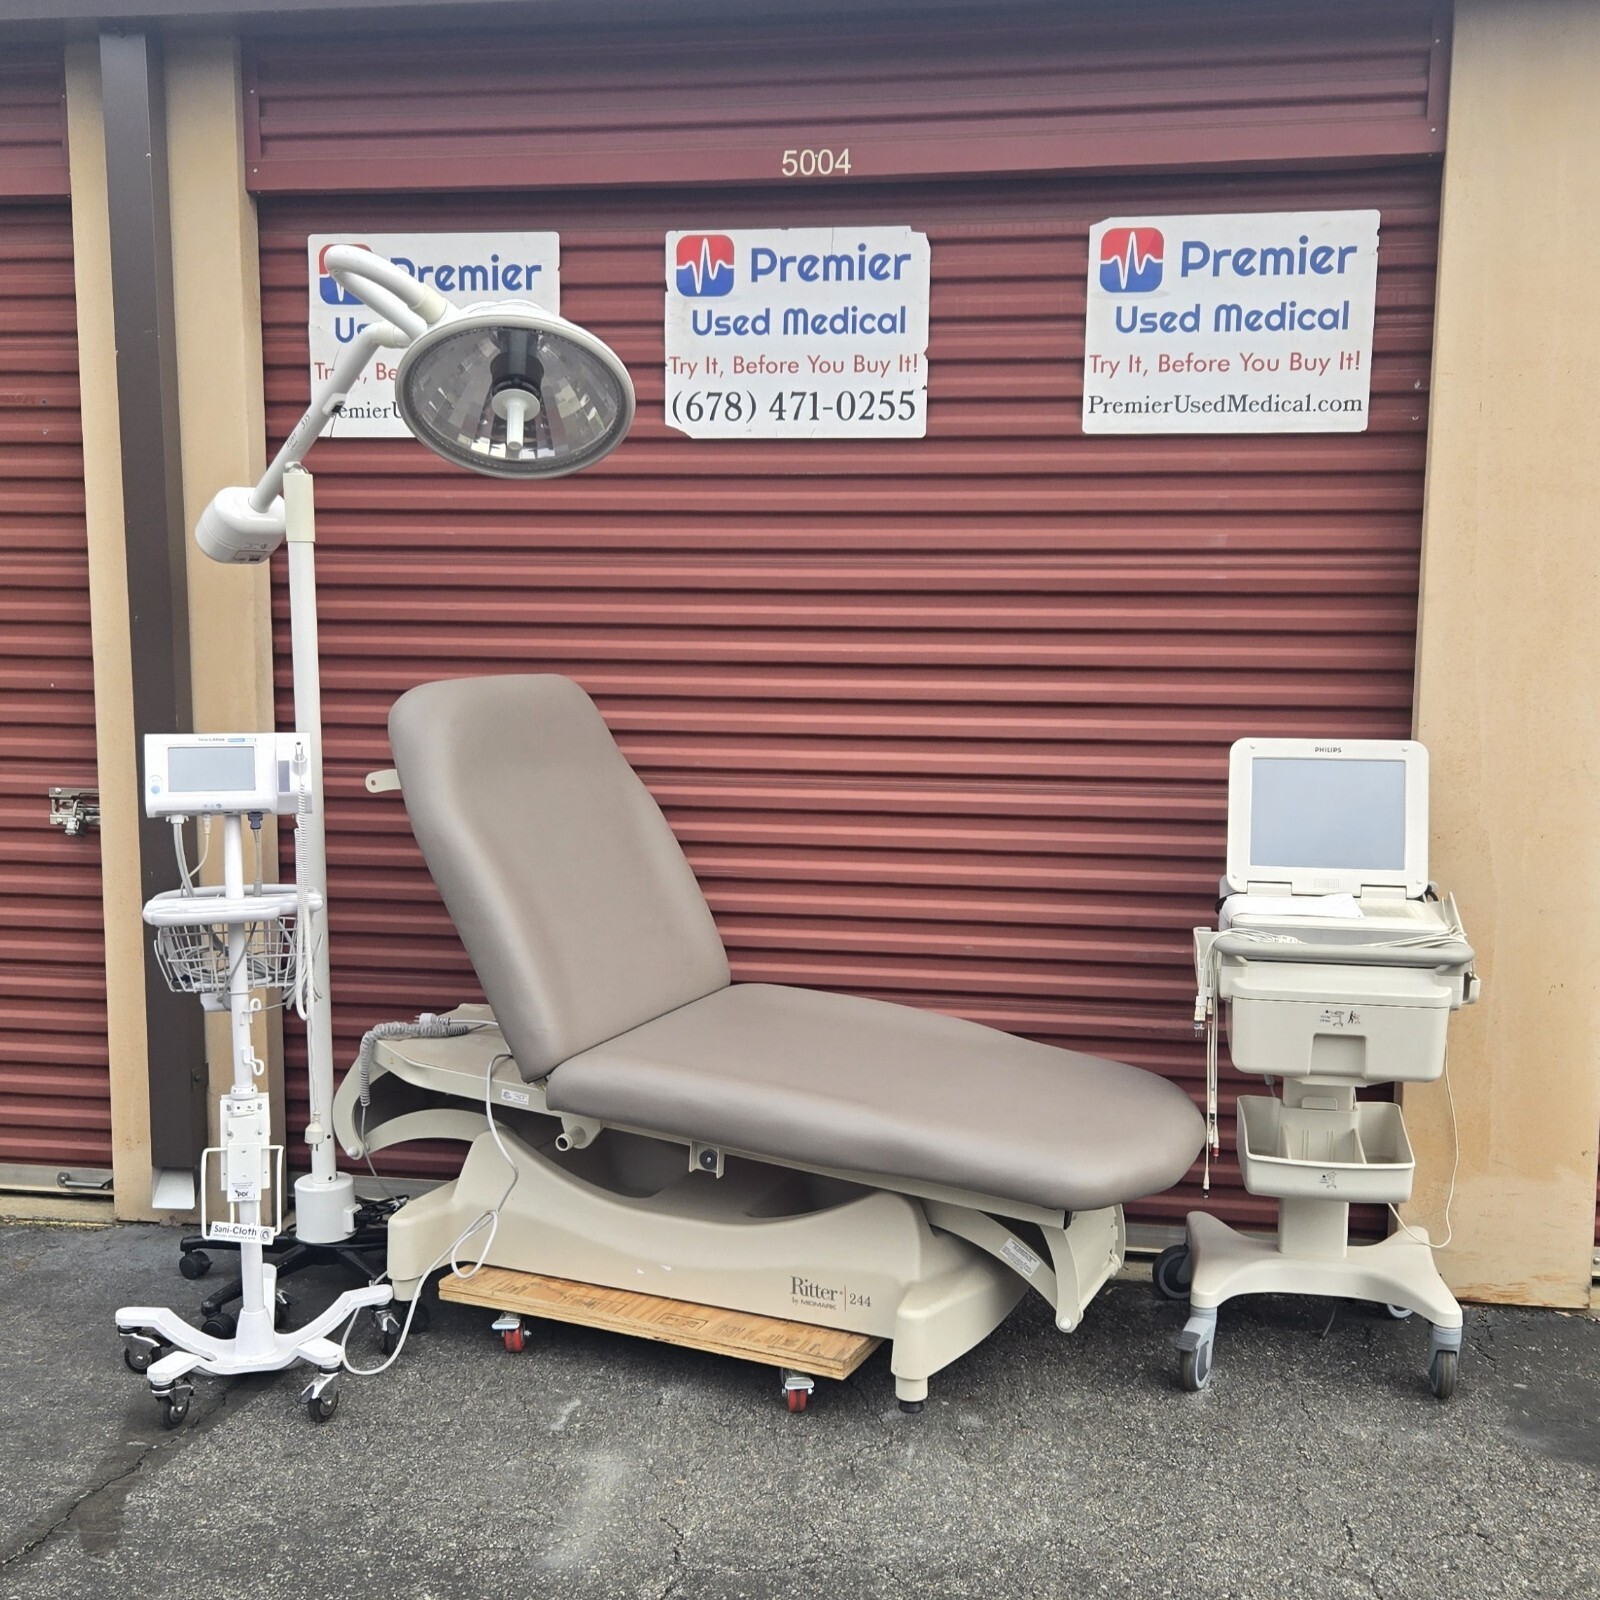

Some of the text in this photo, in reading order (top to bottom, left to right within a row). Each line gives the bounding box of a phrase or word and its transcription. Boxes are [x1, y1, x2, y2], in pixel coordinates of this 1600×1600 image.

[782, 148, 852, 176] 5004
[751, 243, 911, 283] Premier
[1181, 235, 1358, 278] Premier
[692, 305, 906, 336] Used Medical
[1115, 300, 1350, 334] Used Medical
[668, 353, 918, 379] Try It, Before You Buy It!
[1089, 350, 1361, 379] Try It, Before You Buy It!
[672, 388, 916, 424] (678) 471-0255
[1088, 394, 1363, 414] PremierUsedMedical.com
[213, 1224, 257, 1235] Sani-Cloth
[790, 1276, 872, 1307] Ritter 244
[800, 1299, 837, 1310] MIDMARK
